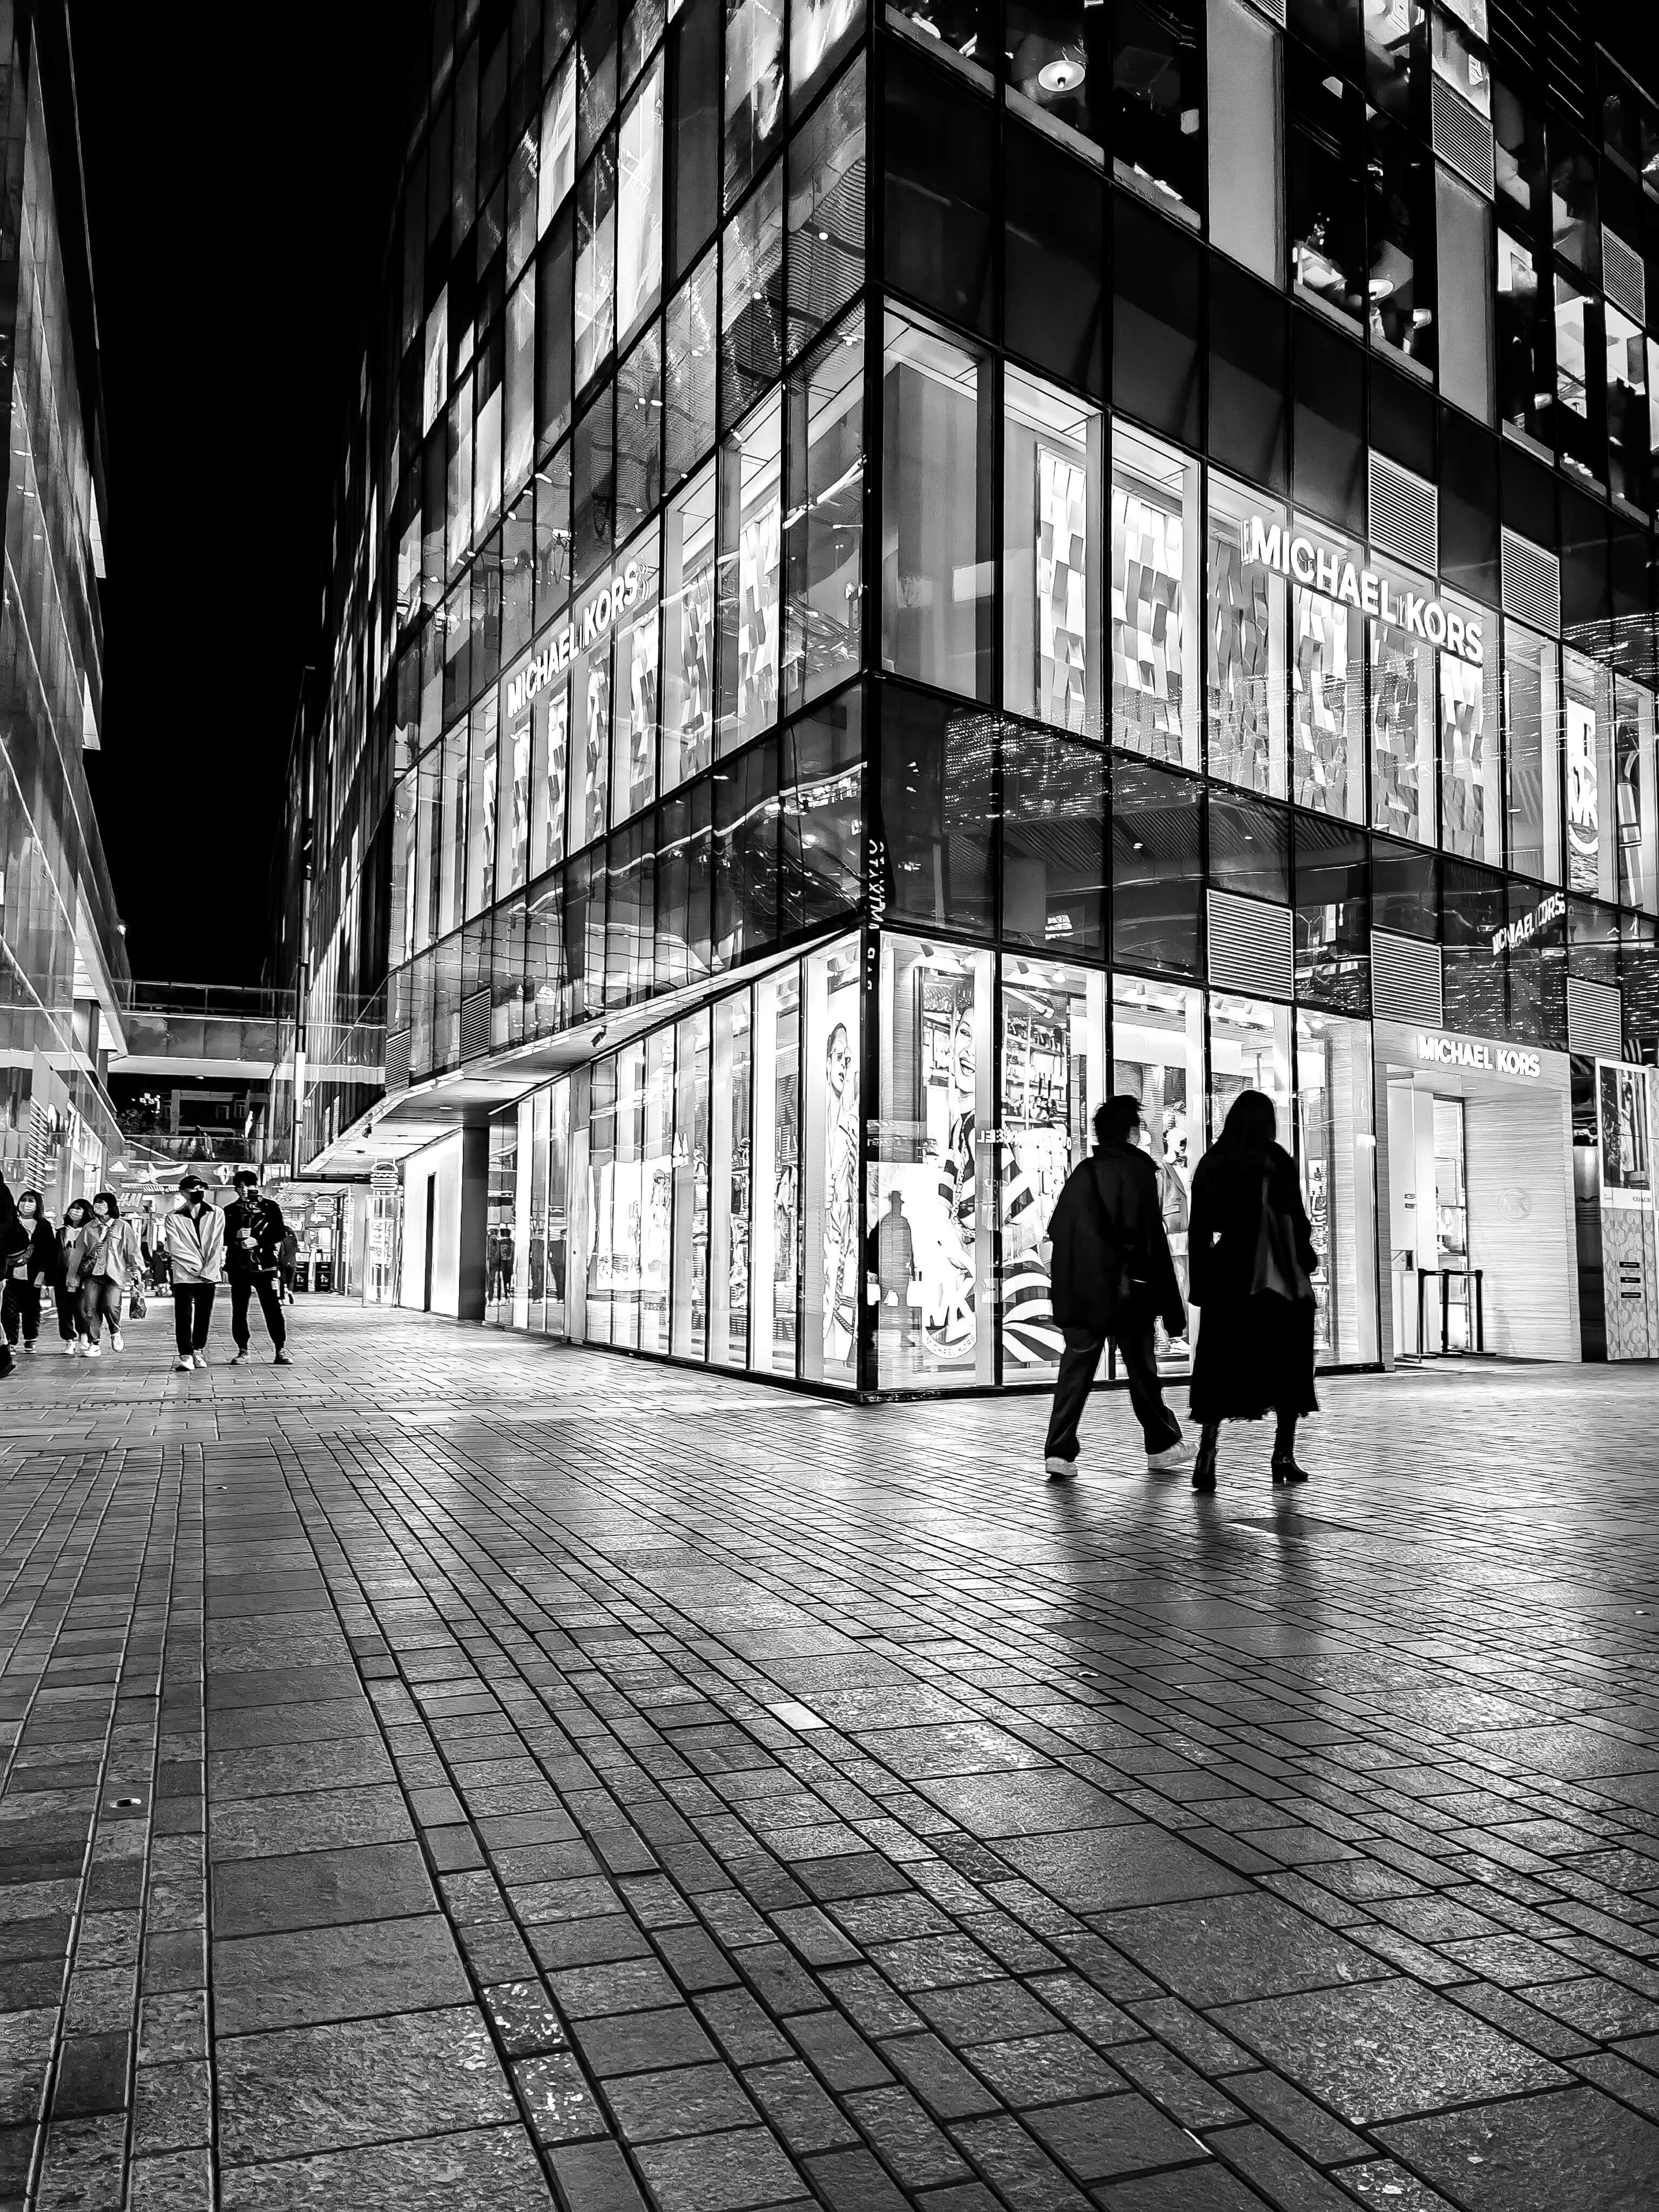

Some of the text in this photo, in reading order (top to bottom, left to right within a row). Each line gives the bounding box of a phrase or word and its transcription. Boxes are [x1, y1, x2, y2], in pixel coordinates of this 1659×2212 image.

[508, 561, 638, 718] MICHAEL KORS
[1251, 515, 1483, 663] MICHAEL KORS
[1417, 1035, 1540, 1078] MICHAEL KORS
